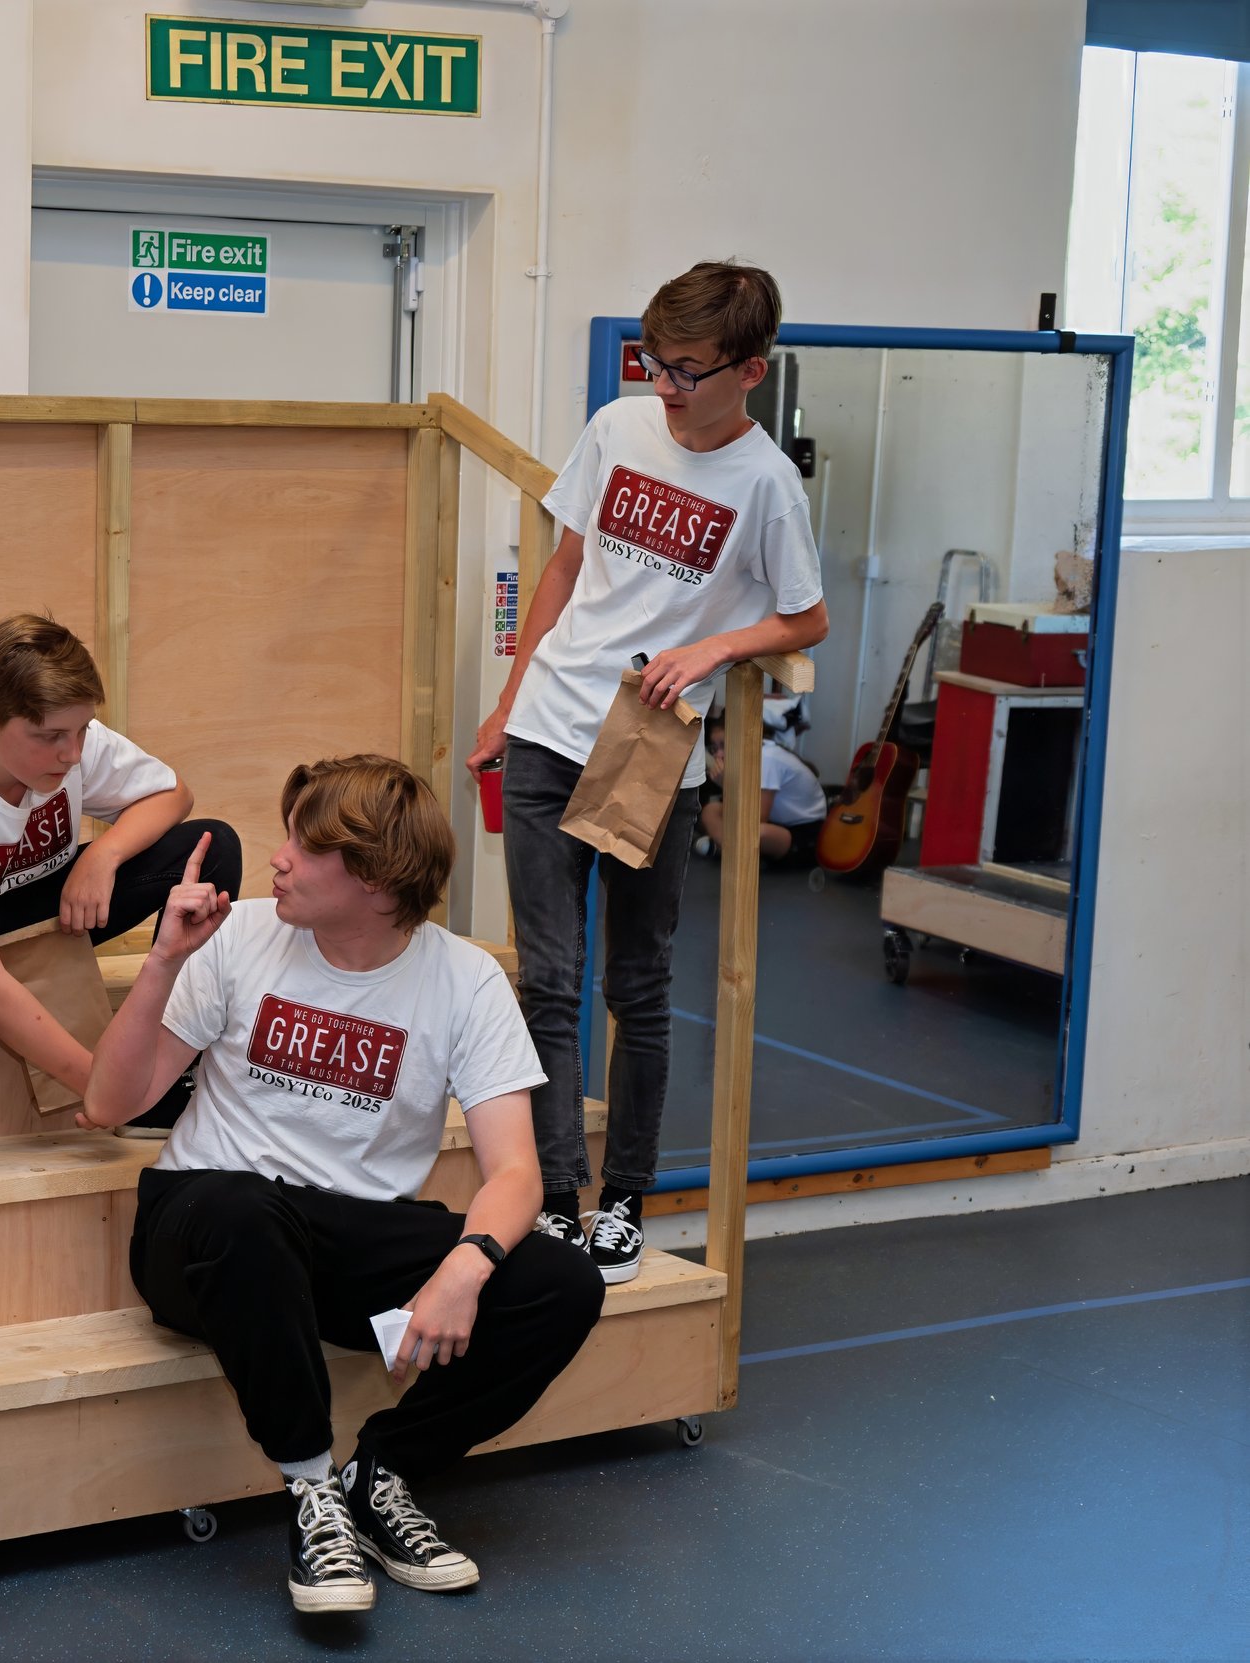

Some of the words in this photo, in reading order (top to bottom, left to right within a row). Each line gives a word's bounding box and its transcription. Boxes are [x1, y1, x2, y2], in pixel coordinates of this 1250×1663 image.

[168, 28, 309, 96] FIRE
[331, 39, 466, 103] EXIT
[171, 237, 216, 263] Fire
[218, 241, 263, 267] exit
[170, 281, 215, 305] Keep
[218, 283, 262, 304] clear
[638, 480, 651, 492] WE
[653, 485, 665, 497] GO
[666, 490, 706, 514] TOGETHER
[612, 487, 721, 554] GREASE
[598, 534, 662, 571] DOSYTCo
[667, 563, 704, 586] 2025
[621, 526, 641, 540] THE
[645, 535, 686, 560] MUSICAL
[293, 1008, 308, 1021] WE
[311, 1013, 323, 1025] GO
[328, 1017, 375, 1037] TOGETHER
[266, 1016, 394, 1079] GREASE
[248, 1065, 333, 1101] DOSYTCo
[340, 1092, 383, 1114] 2025
[280, 1058, 301, 1073] THE
[308, 1066, 361, 1088] MUSICAL
